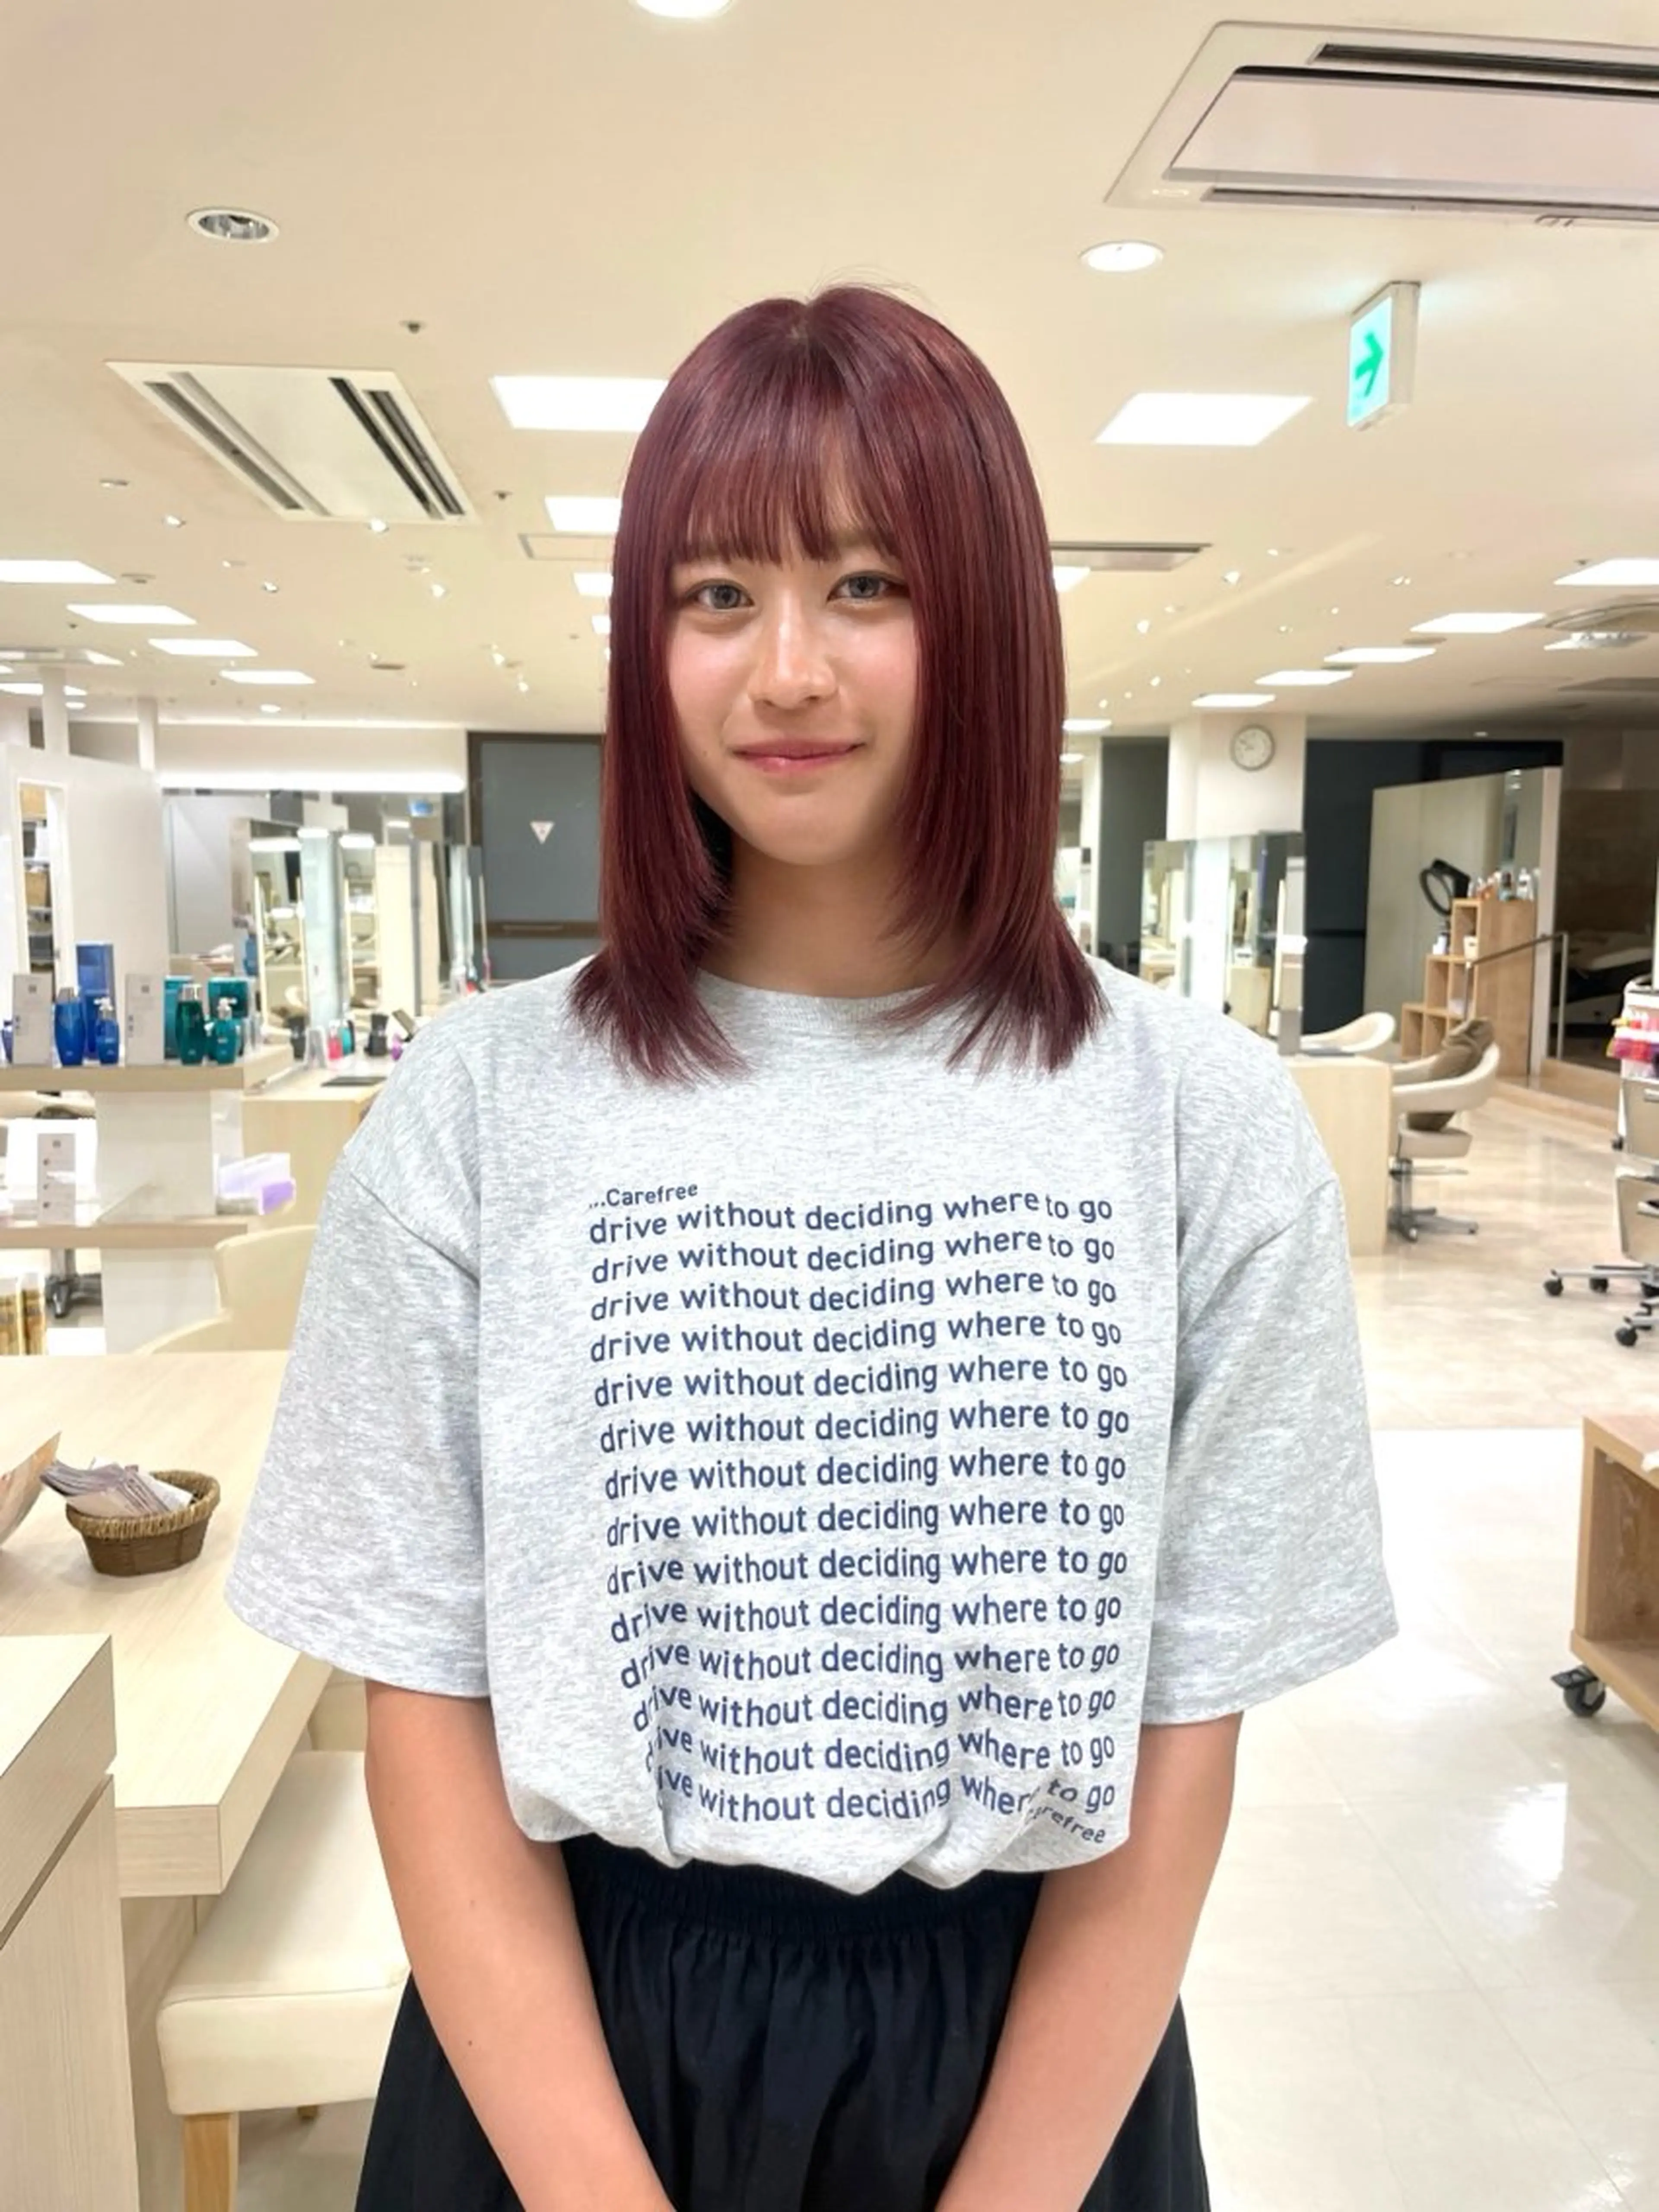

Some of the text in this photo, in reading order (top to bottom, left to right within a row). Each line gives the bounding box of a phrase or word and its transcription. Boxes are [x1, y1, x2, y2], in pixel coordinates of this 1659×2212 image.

[589, 1192, 1112, 1245] drive without deciding where to go
[592, 1230, 1115, 1284] drive without deciding where to go
[591, 1269, 1117, 1321] drive without deciding where to go
[590, 1310, 1122, 1363] drive without deciding where to go
[594, 1354, 1128, 1408] drive without deciding where to go
[600, 1399, 1129, 1454] drive without deciding where to go
[605, 1446, 1126, 1500] drive without deciding where to go
[607, 1494, 1125, 1548] drive without deciding where to go
[607, 1544, 1128, 1595] drive without deciding where to go
[610, 1593, 1122, 1644] drive without deciding where to go
[620, 1642, 1120, 1689] drive without deciding where to go
[698, 1694, 813, 1728] without
[822, 1689, 948, 1729] deciding
[957, 1682, 1053, 1722] where
[1057, 1690, 1082, 1718] to
[1087, 1689, 1116, 1720] go
[699, 1740, 814, 1776] without
[824, 1738, 950, 1773] deciding
[957, 1727, 1051, 1770] where
[1061, 1740, 1083, 1767] to
[1090, 1735, 1115, 1769] go
[699, 1784, 815, 1823] without
[826, 1777, 951, 1820] deciding
[960, 1774, 1039, 1815] wher
[1046, 1777, 1079, 1803] to
[1084, 1785, 1115, 1815] go
